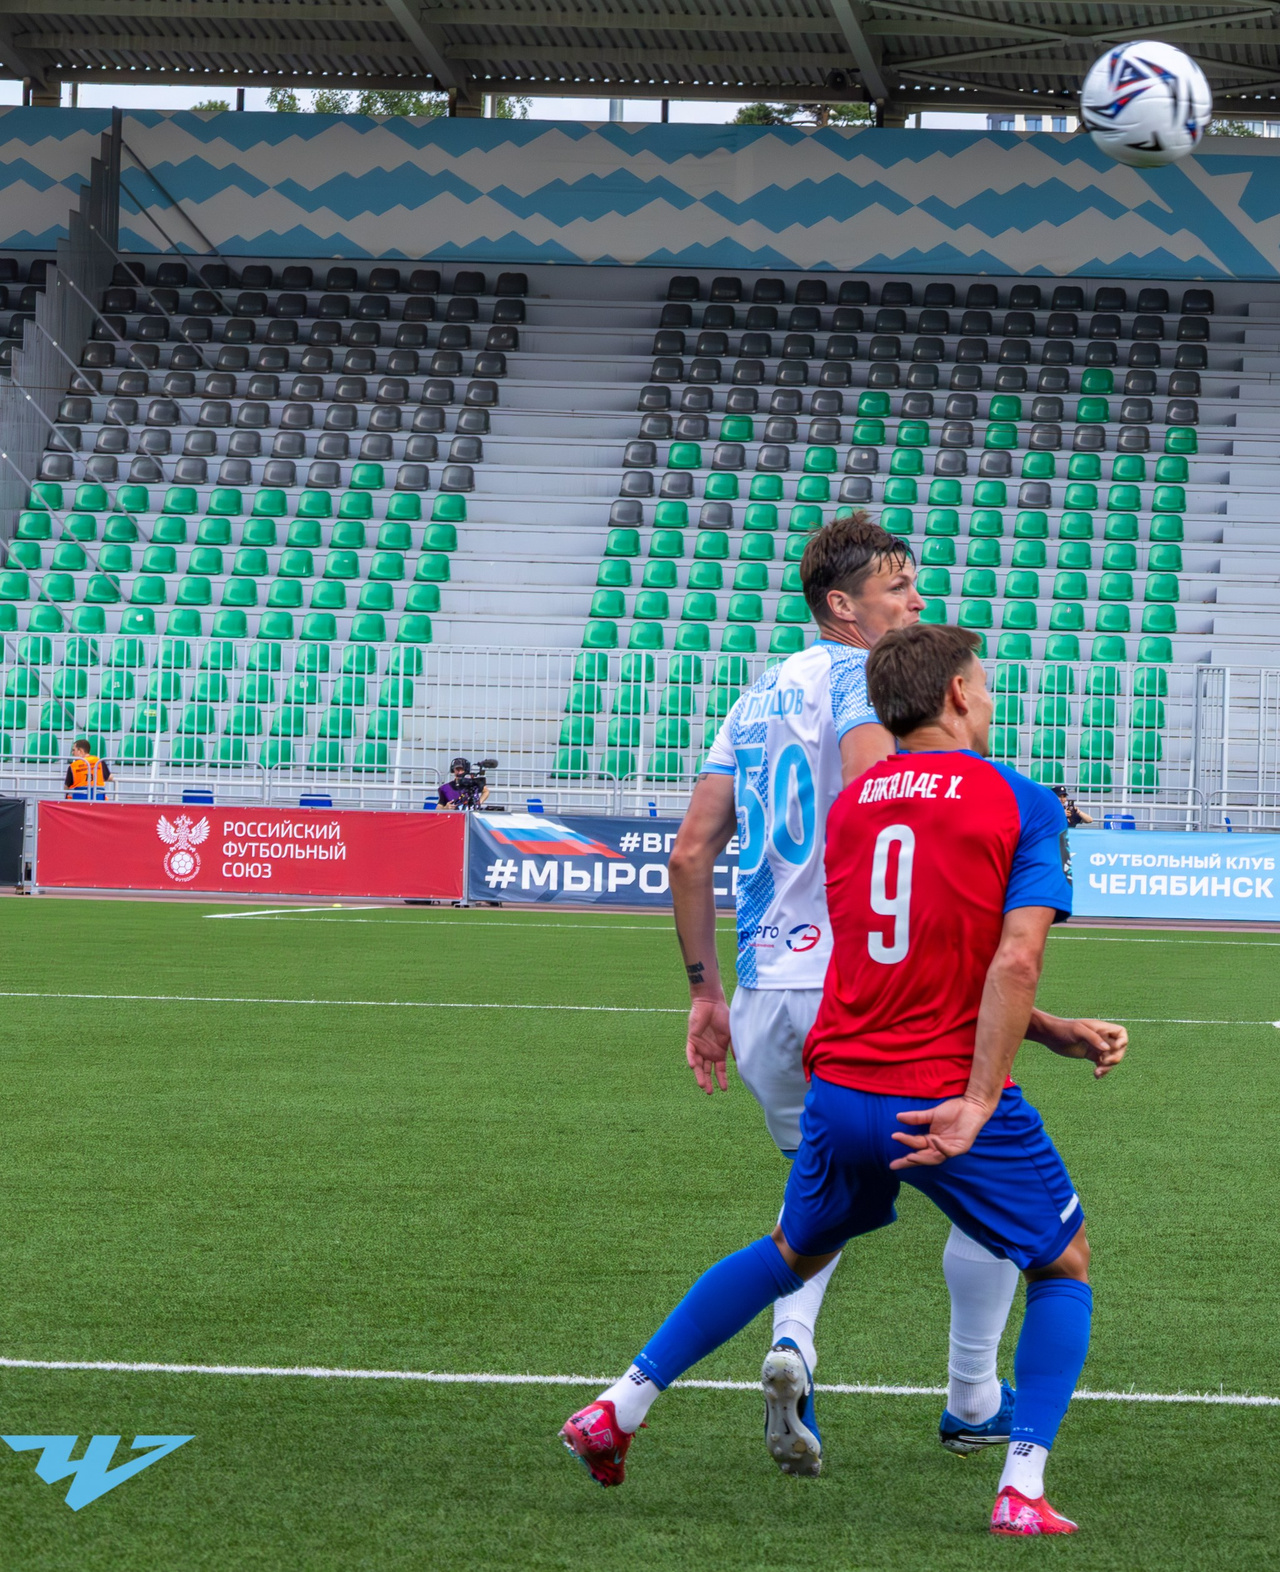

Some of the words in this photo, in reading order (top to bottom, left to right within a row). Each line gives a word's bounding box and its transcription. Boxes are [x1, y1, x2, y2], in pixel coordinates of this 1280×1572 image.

[735, 740, 817, 875] 50
[223, 820, 341, 839] РОССИЙСКИЙ
[222, 841, 347, 860] ФУТБОЛЬНЫЙ
[222, 862, 272, 878] СОЮЗ
[1089, 853, 1221, 869] ФУТБОЛЬНЫЙ
[1226, 857, 1275, 870] КЛУБ
[868, 824, 915, 965] 9
[1088, 873, 1274, 898] ЧЕЛЯБИНСК
